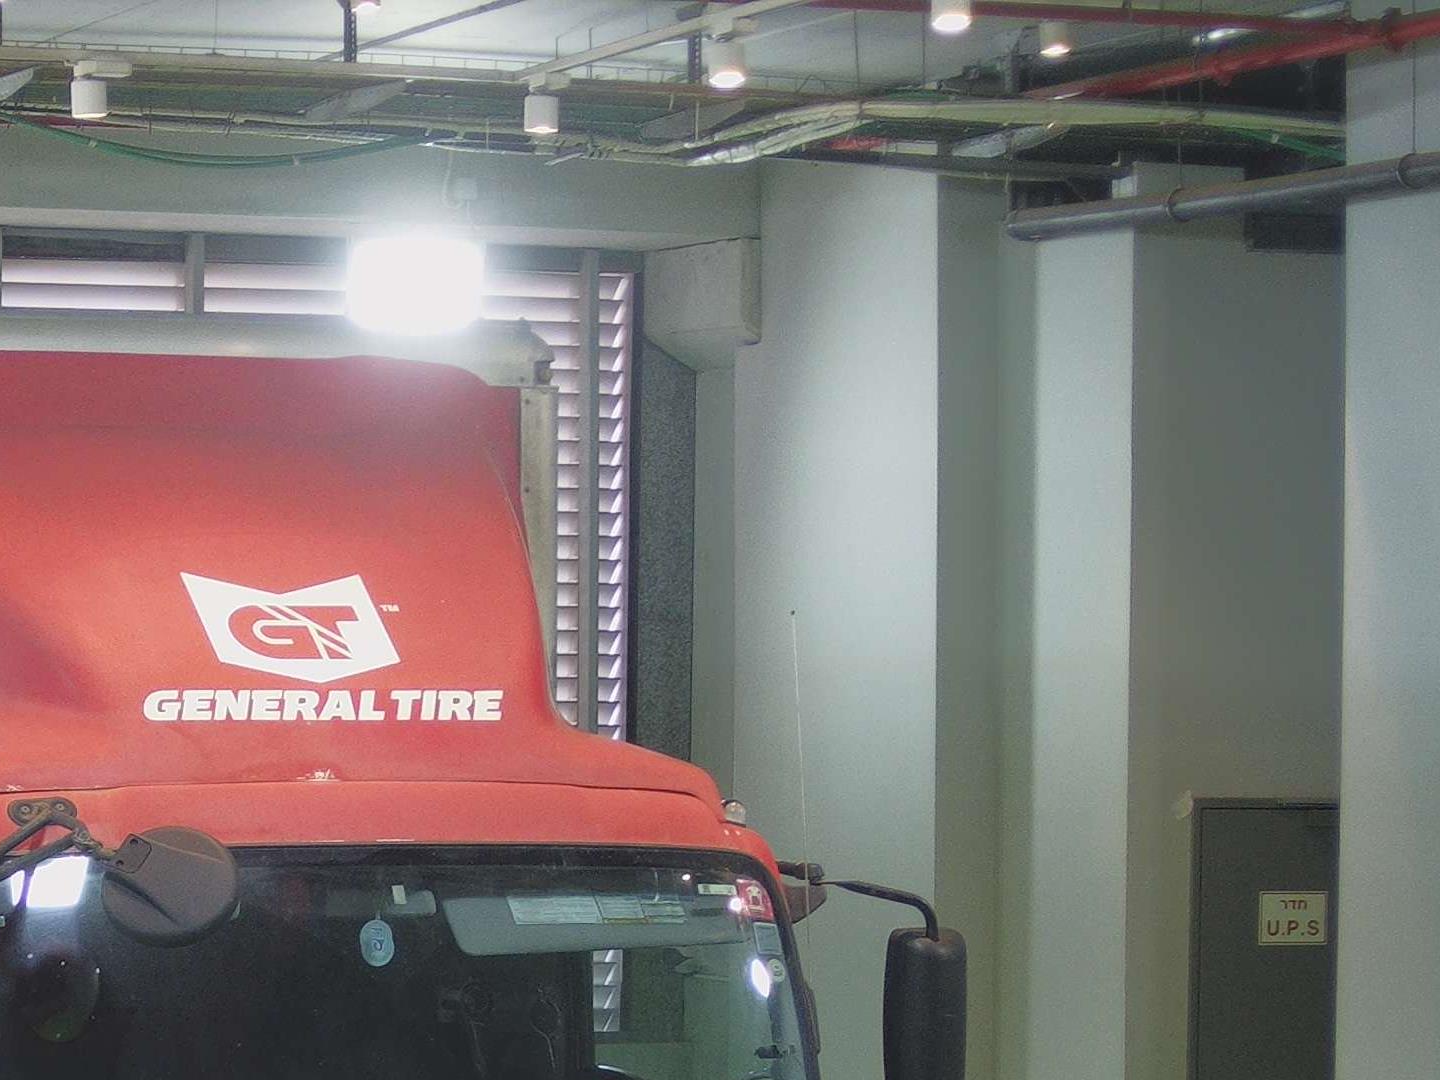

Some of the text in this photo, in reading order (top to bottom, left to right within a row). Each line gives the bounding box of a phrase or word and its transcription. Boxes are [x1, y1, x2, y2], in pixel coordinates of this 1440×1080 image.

[142, 689, 504, 722] GENERAL TIRE
[1267, 919, 1320, 936] U.P.S
